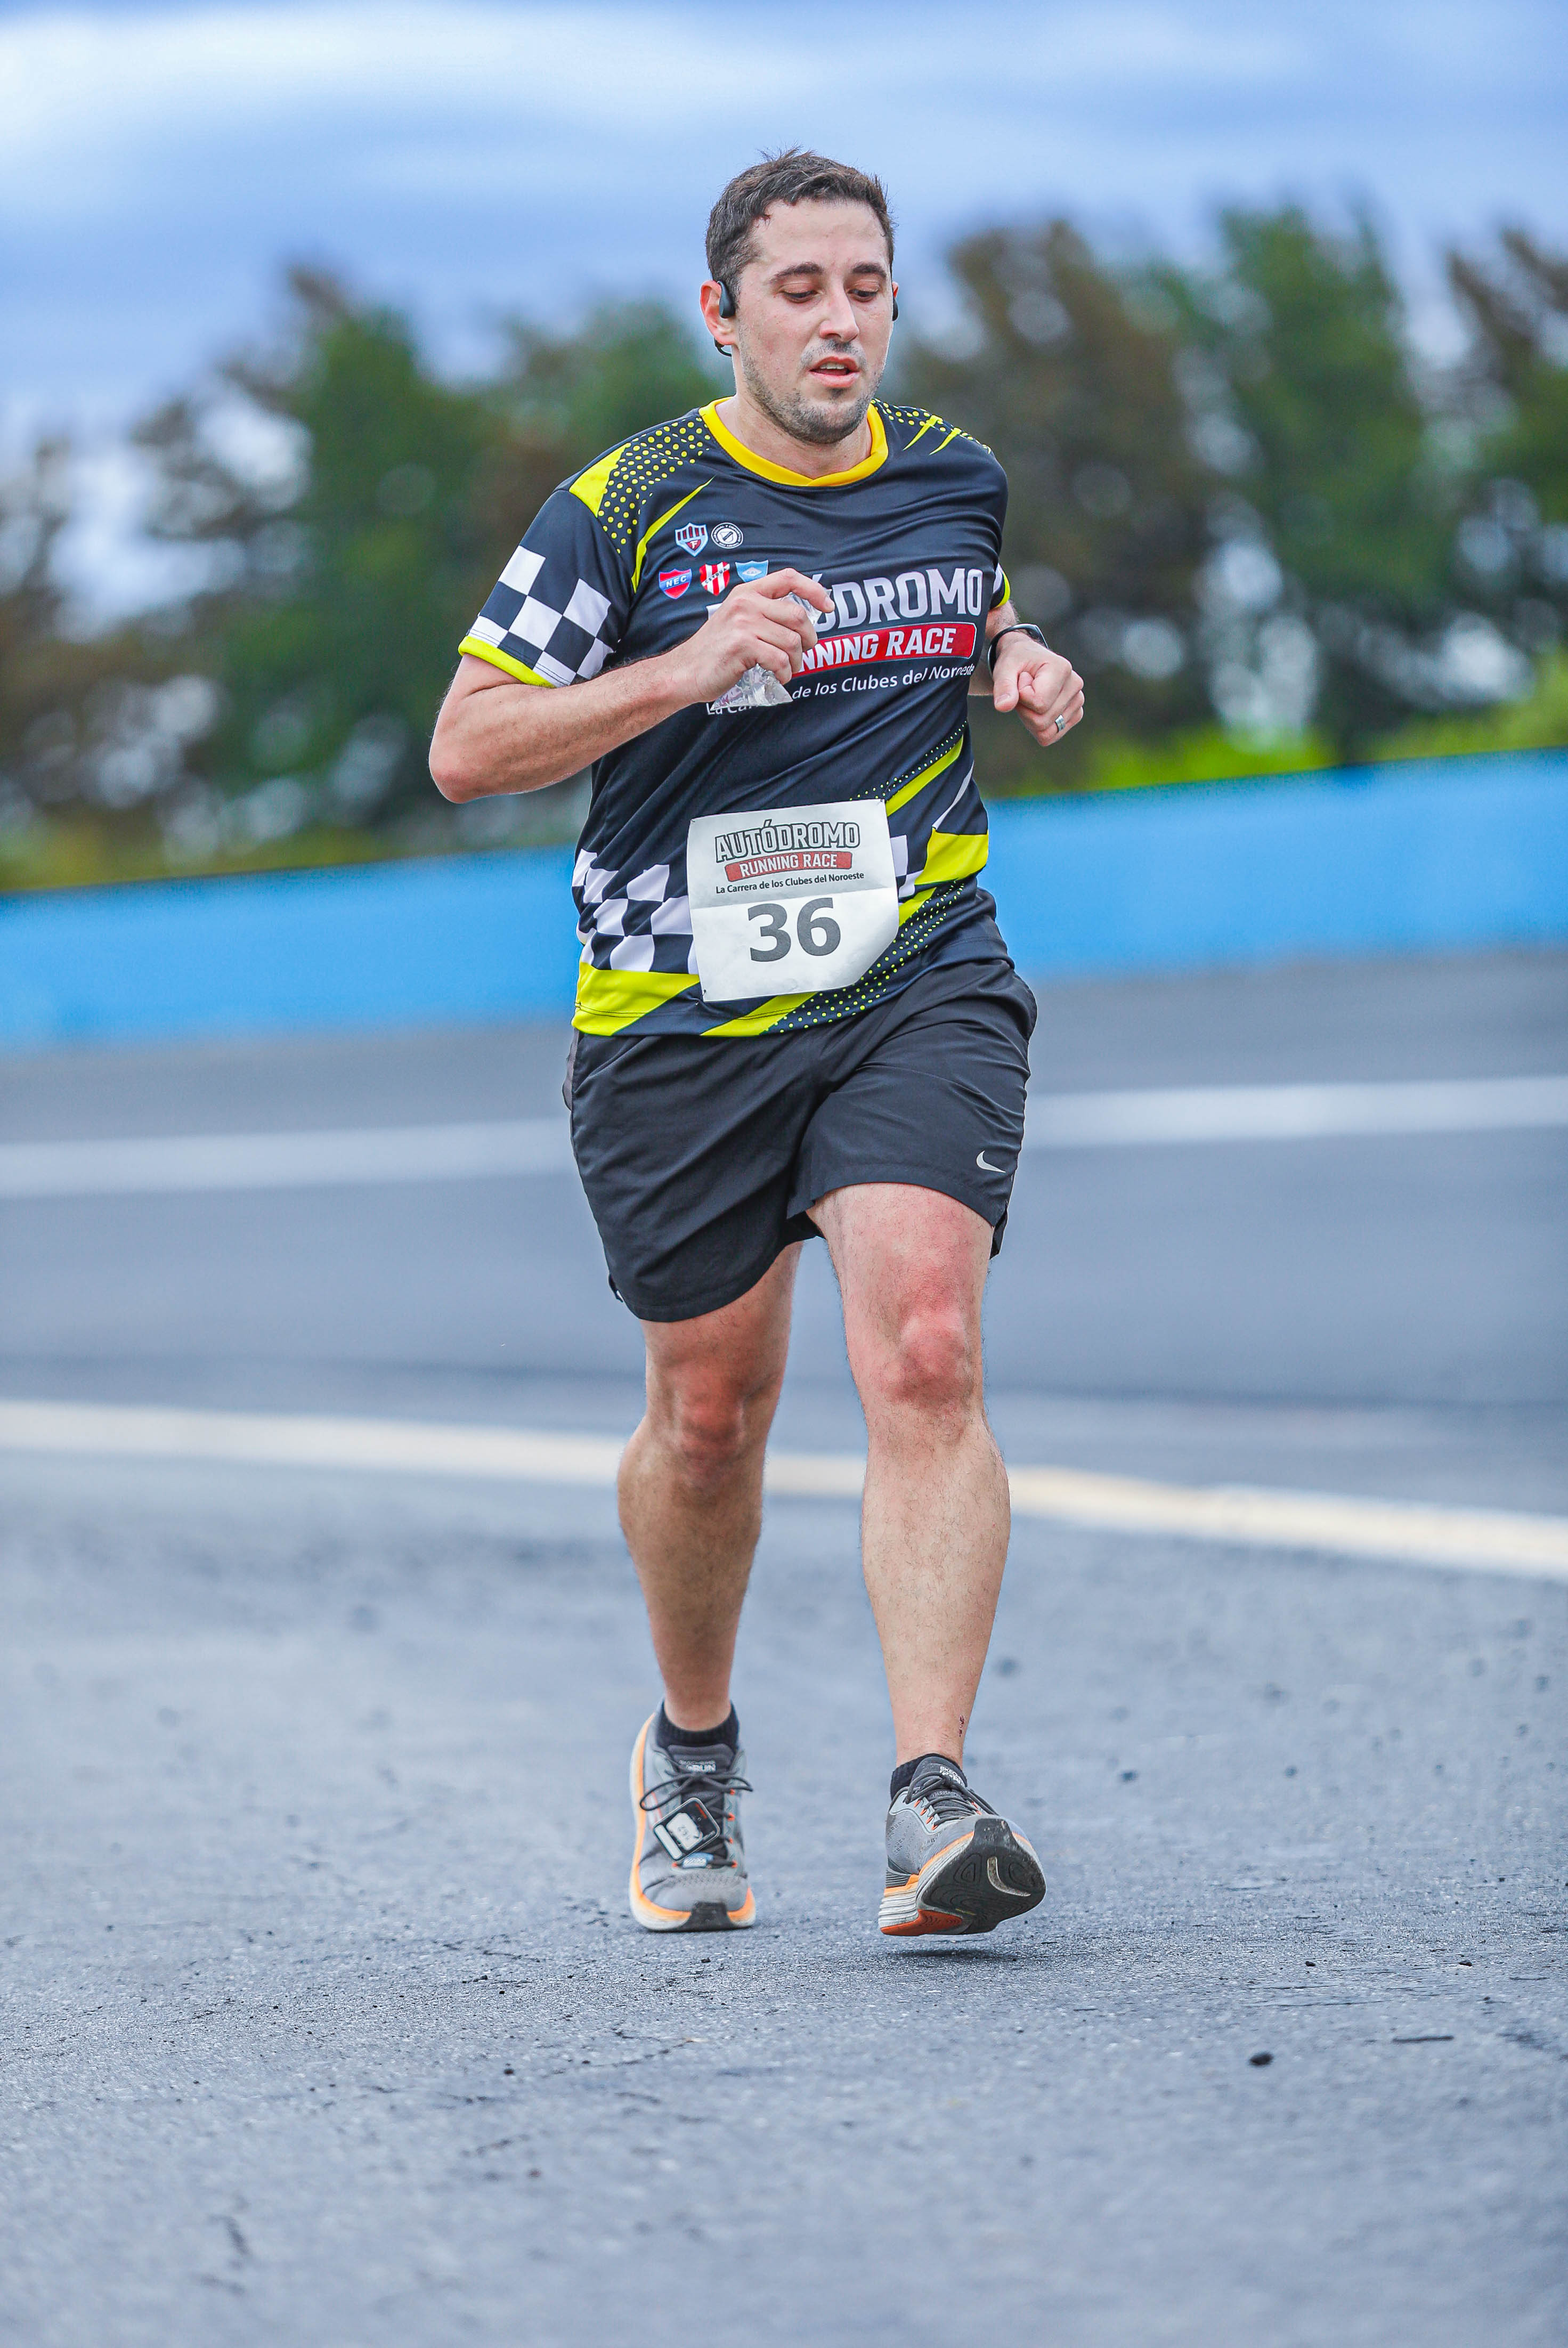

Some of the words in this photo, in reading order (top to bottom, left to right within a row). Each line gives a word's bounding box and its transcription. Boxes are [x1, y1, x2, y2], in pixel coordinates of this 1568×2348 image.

[666, 575, 687, 588] NEC
[800, 633, 880, 673] NNING
[885, 628, 957, 657] RACE
[792, 686, 811, 699] de
[815, 683, 837, 695] los
[841, 676, 898, 692] Clubes
[903, 667, 927, 685] del
[715, 819, 860, 863] AUTÓDROMO
[739, 854, 799, 878] RUNNING
[803, 853, 838, 868] RACE
[771, 879, 784, 888] los
[785, 878, 813, 887] Clubes
[814, 874, 827, 883] del
[829, 871, 864, 882] Noroeste
[748, 897, 841, 962] 36
